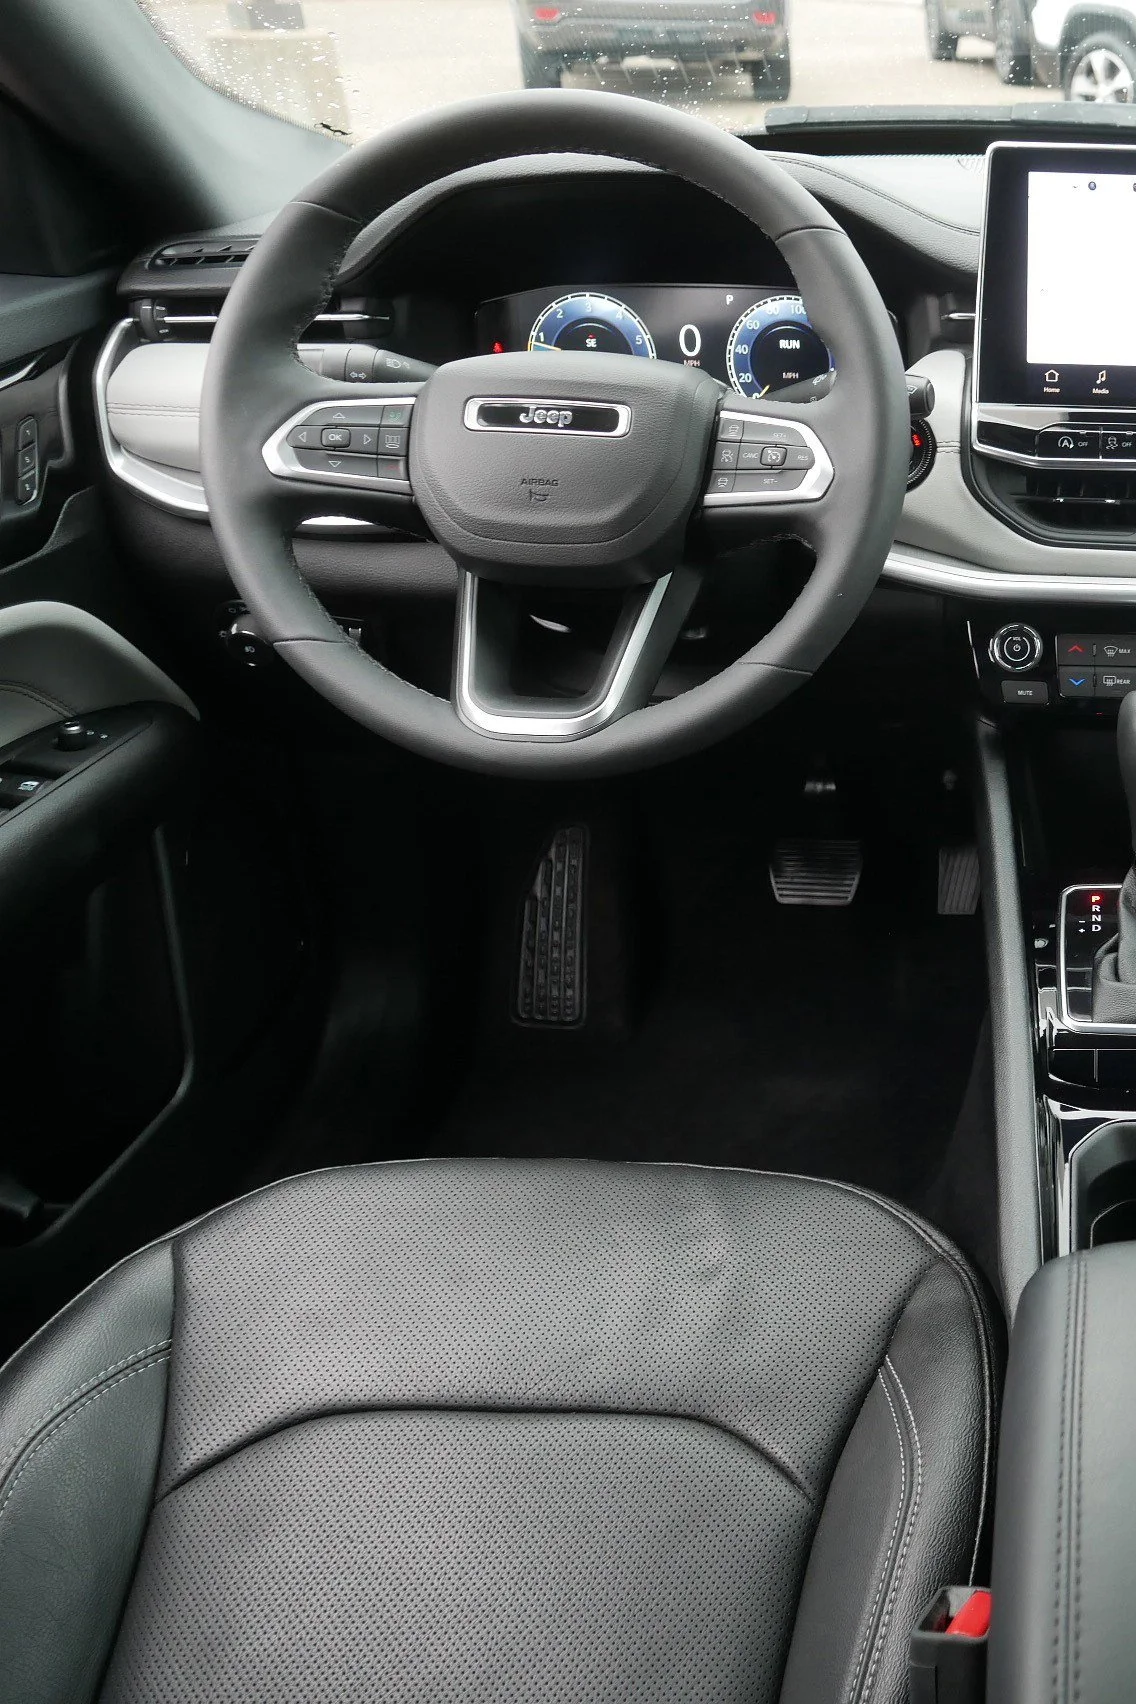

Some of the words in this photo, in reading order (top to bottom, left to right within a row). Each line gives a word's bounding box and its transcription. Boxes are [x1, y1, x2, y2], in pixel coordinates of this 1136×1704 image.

[725, 294, 734, 305] P
[585, 301, 592, 312] 3
[556, 308, 564, 318] 2
[615, 308, 623, 319] 4
[746, 321, 760, 330] 60
[538, 332, 545, 342] 1
[635, 335, 643, 345] 5
[679, 324, 701, 357] 0
[585, 339, 597, 348] SE
[779, 339, 800, 349] RUN
[735, 344, 749, 355] 40
[683, 359, 700, 367] MPH
[738, 372, 752, 383] 20
[519, 405, 573, 427] Jeep
[328, 433, 342, 441] OK
[520, 478, 559, 487] AIRBAG
[1091, 895, 1101, 903] P
[1091, 904, 1101, 912] R
[1091, 914, 1102, 922] N
[1091, 924, 1102, 932] D
